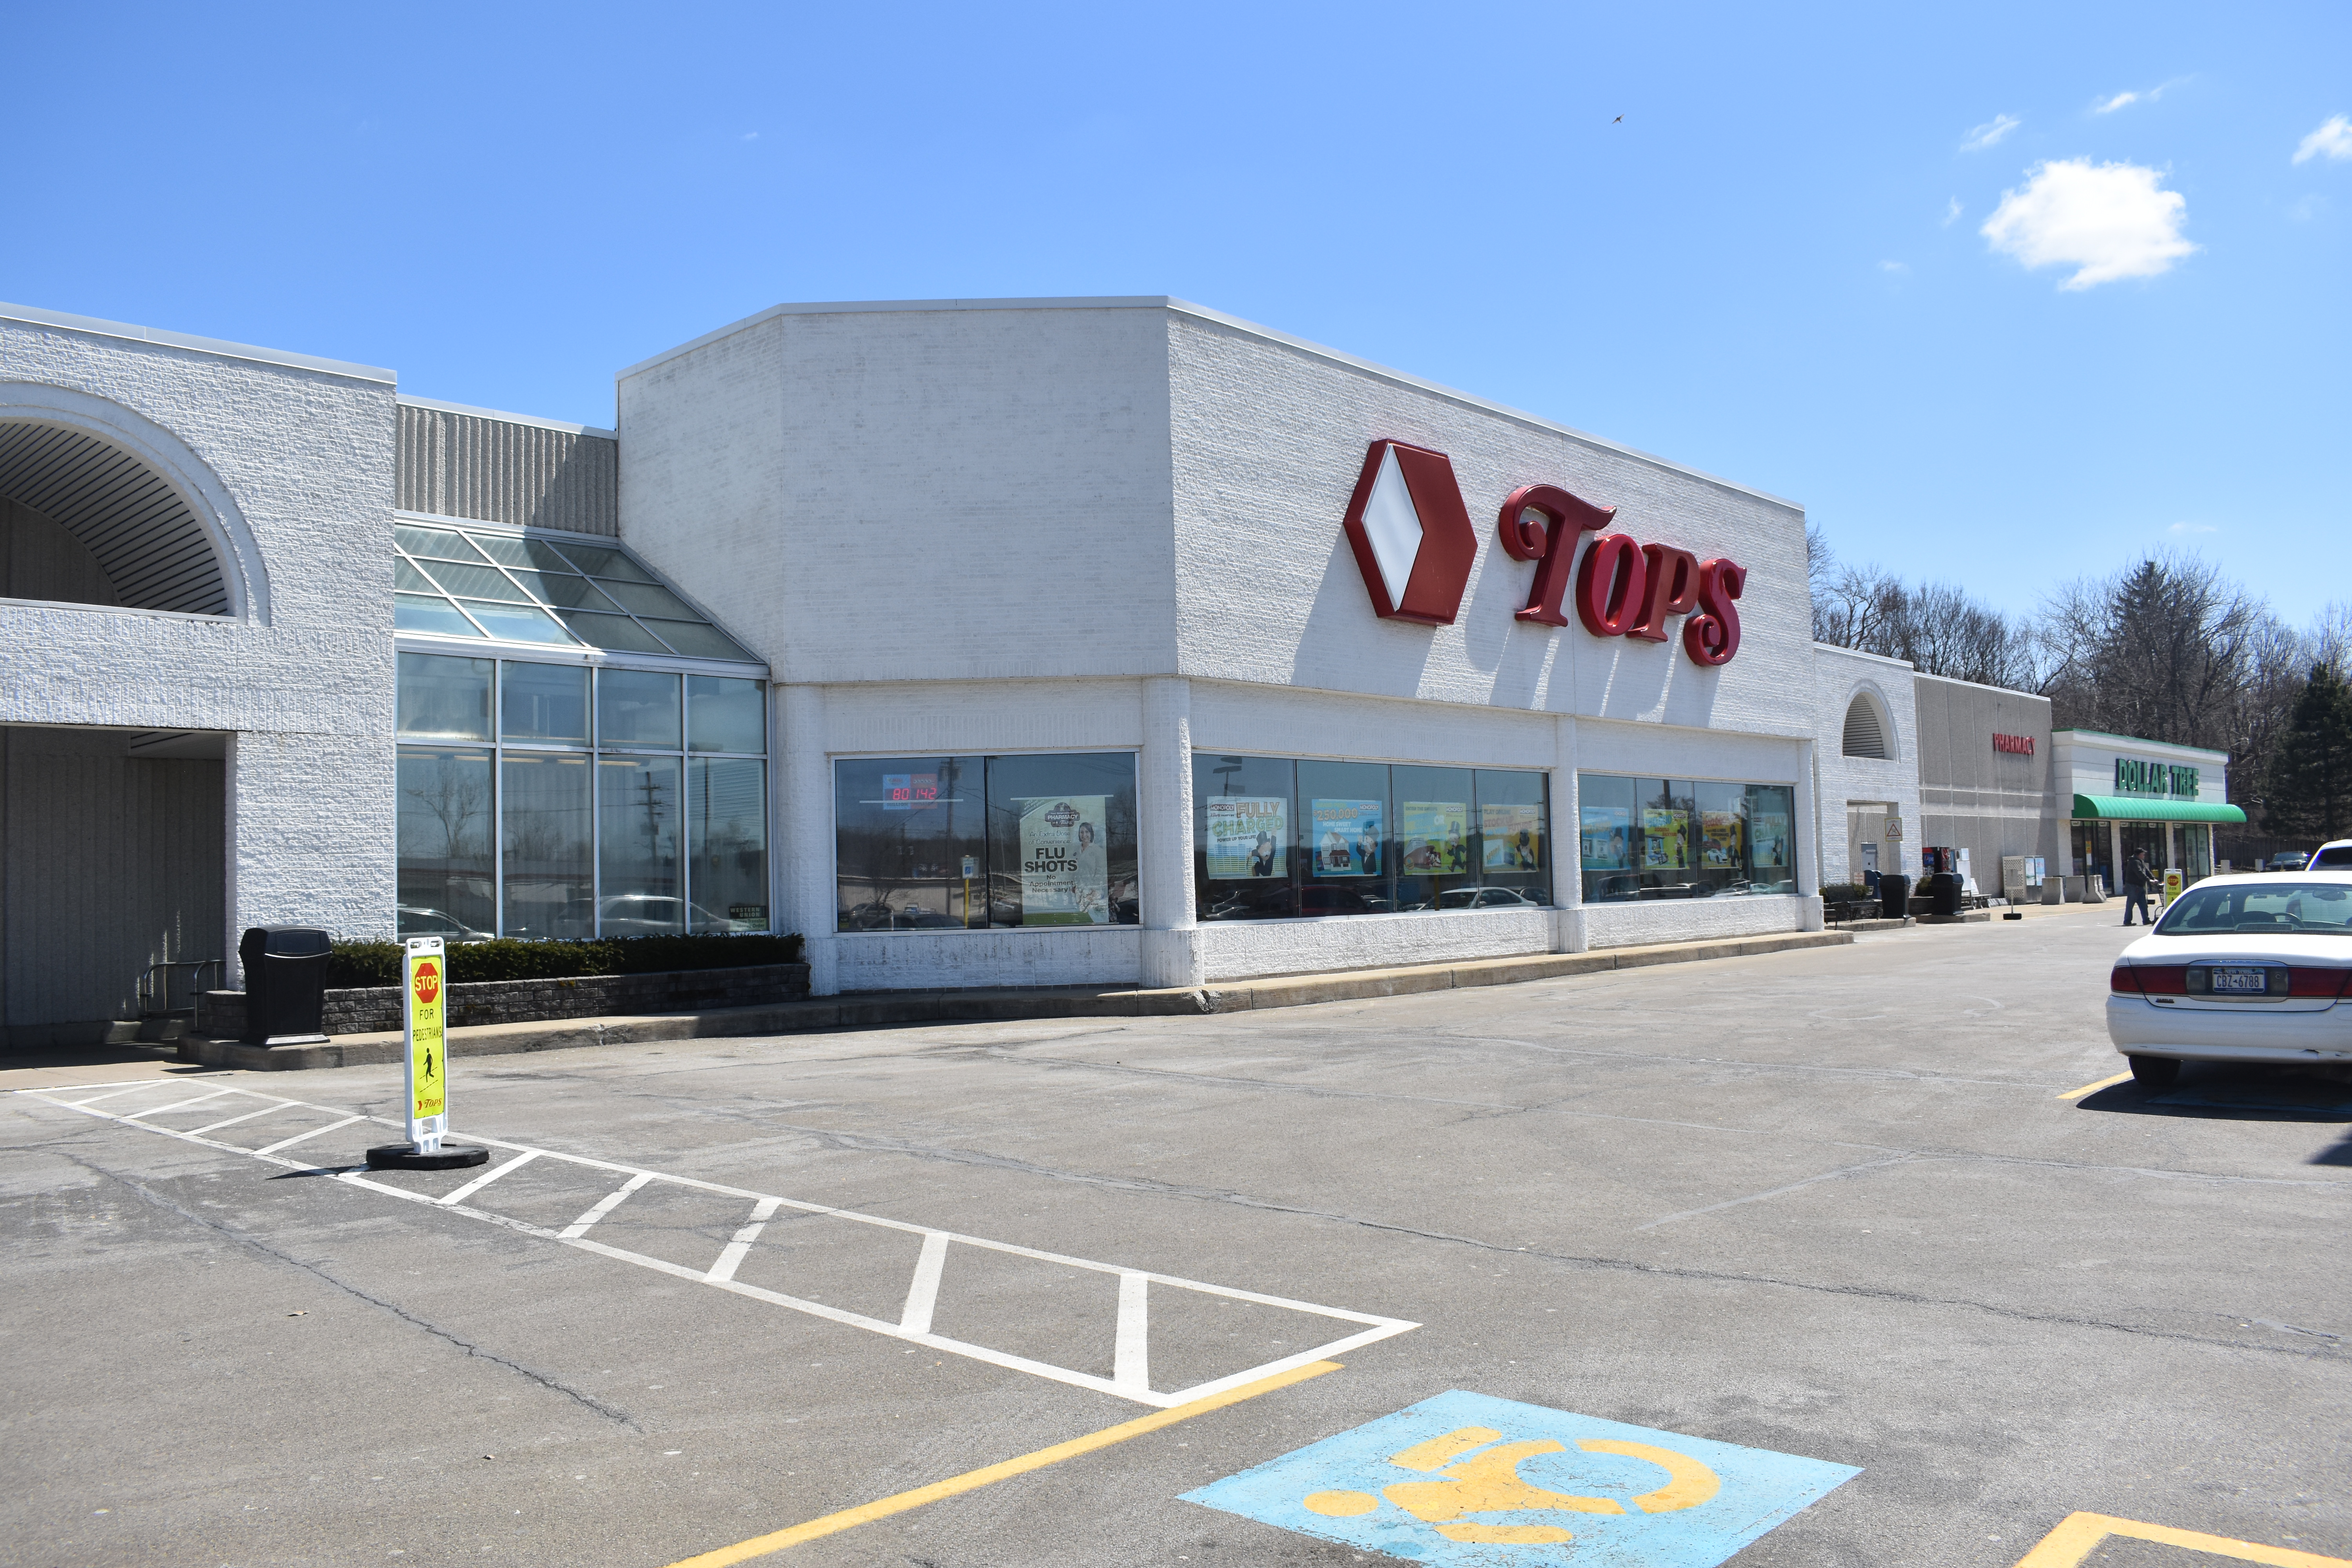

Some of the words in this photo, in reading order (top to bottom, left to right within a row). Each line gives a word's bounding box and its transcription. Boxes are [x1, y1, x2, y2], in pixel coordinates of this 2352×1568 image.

[1993, 733, 2035, 755] PHARMACY
[2116, 759, 2168, 793] DOLLAR
[2169, 765, 2199, 796] TREE
[893, 788, 909, 800] 80
[916, 788, 937, 800] 142
[1236, 802, 1280, 818] FULLY
[1314, 808, 1358, 821] $250,000
[1212, 815, 1284, 837] CHARGED
[1036, 847, 1065, 859] FLU
[1024, 860, 1078, 873] SHOTS
[415, 975, 438, 991] STOP
[420, 1008, 434, 1020] FOR
[413, 1026, 442, 1042] PEDESTRIANS
